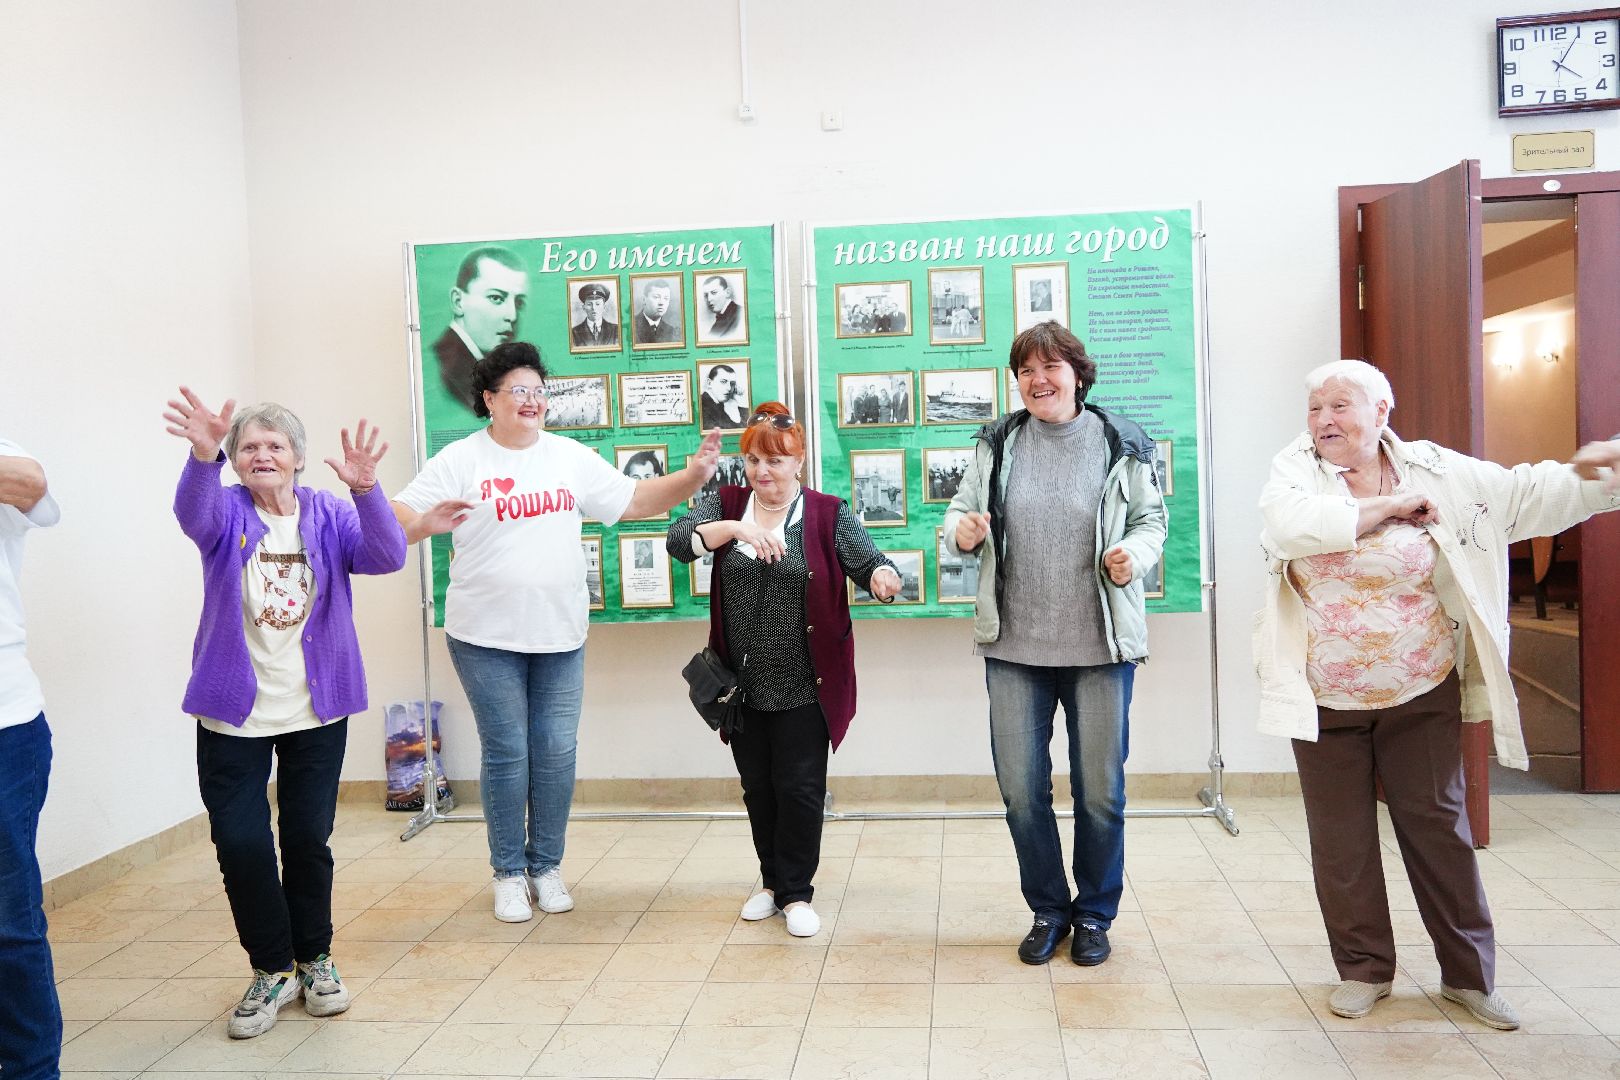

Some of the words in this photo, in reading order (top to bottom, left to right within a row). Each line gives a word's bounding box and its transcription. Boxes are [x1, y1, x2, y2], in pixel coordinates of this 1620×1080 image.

[1534, 29, 1545, 42] 11
[1550, 27, 1567, 40] 12
[1577, 26, 1581, 39] 1
[1594, 31, 1607, 45] 2
[1509, 38, 1525, 52] 10
[1602, 54, 1616, 68] 3
[1504, 62, 1517, 76] 9
[1511, 84, 1524, 98] 8
[1595, 78, 1608, 91] 4
[1535, 90, 1547, 104] 7
[1553, 89, 1567, 103] 6
[1574, 87, 1587, 101] 5
[1522, 147, 1569, 157] Зрительный
[834, 235, 964, 266] назван
[975, 231, 1056, 258] наш
[1065, 216, 1170, 264] город
[539, 241, 598, 273] Его
[607, 239, 743, 270] именем
[480, 479, 492, 501] Я
[495, 488, 575, 521] РОШАЛЬ
